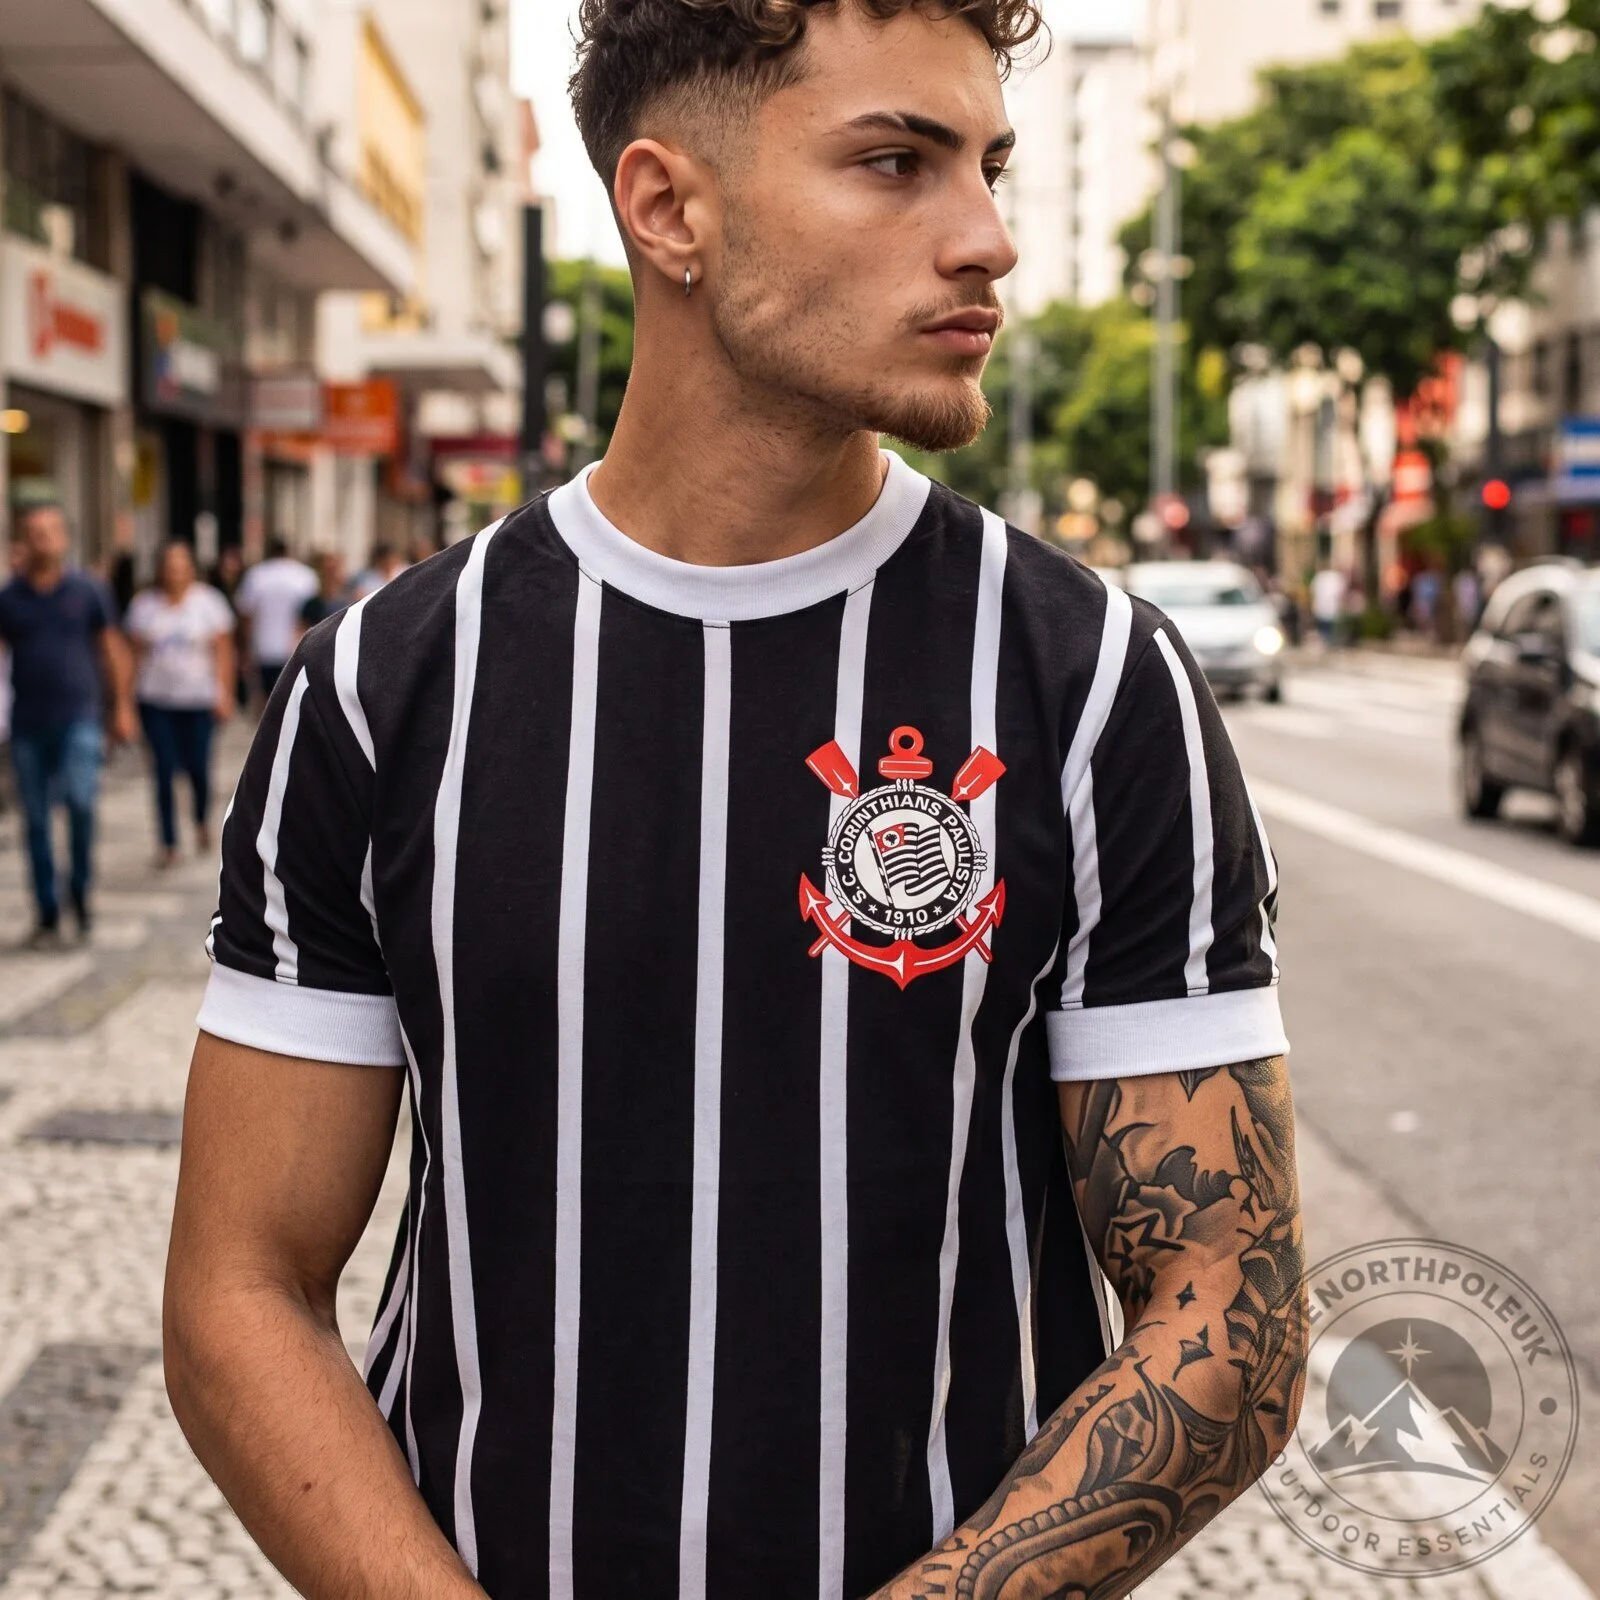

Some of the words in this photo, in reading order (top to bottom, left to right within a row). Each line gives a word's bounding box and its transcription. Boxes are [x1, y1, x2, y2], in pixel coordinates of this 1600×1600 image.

[838, 794, 942, 863] CORINTHIANS
[942, 814, 971, 902] PAULISTA
[884, 908, 928, 925] 1910
